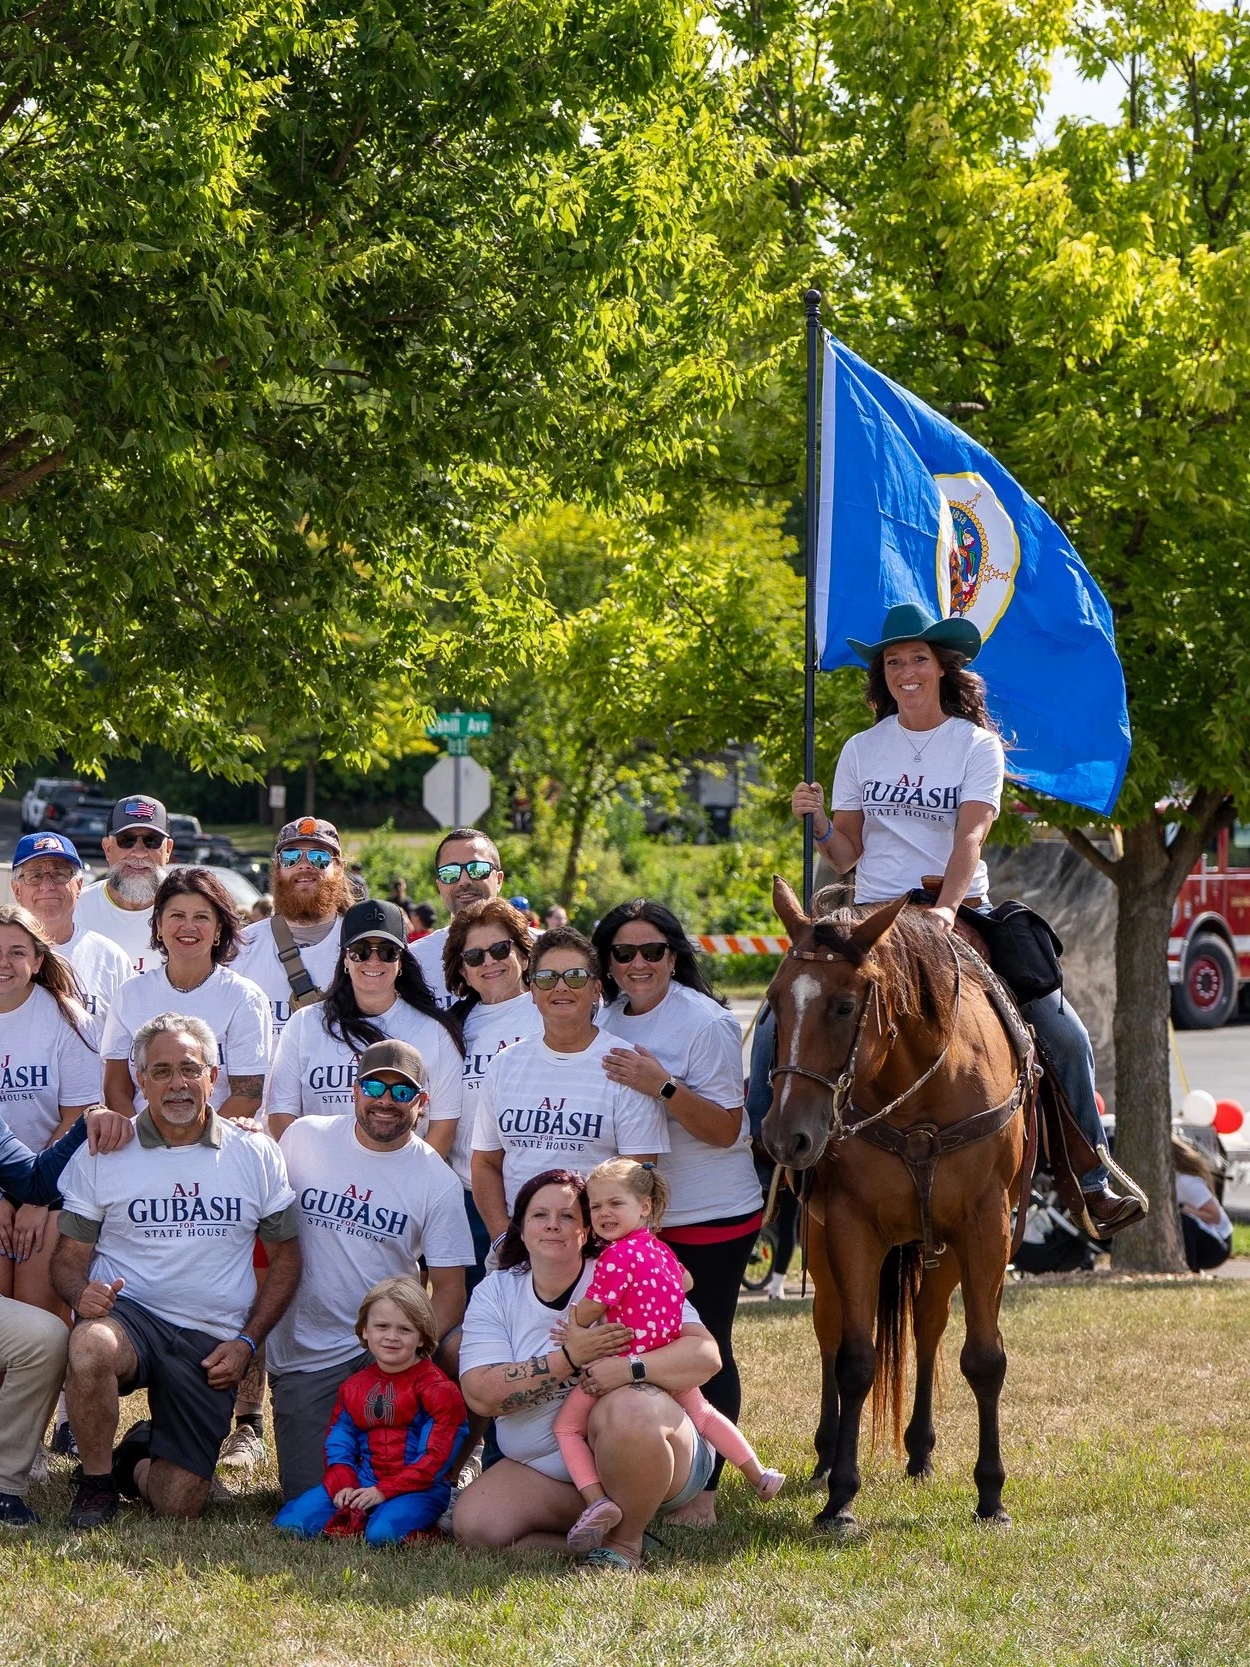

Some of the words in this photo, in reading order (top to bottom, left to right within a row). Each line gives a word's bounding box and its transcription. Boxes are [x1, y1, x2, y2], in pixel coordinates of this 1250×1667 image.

[951, 509, 967, 525] 1858
[467, 716, 489, 734] Ave
[896, 773, 925, 788] AJ
[862, 780, 959, 810] GUBASH
[867, 808, 900, 817] STATE
[905, 809, 945, 823] HOUSE
[0, 1092, 35, 1103] HOUSE
[538, 1097, 567, 1112] AJ
[498, 1108, 605, 1139] GUBASH
[510, 1139, 542, 1149] STATE
[545, 1141, 585, 1152] HOUSE
[172, 1182, 200, 1198] AJ
[343, 1183, 374, 1202] AJ
[127, 1196, 242, 1223] GUBASH
[300, 1187, 409, 1236] GUBASH
[307, 1217, 342, 1232] STATE
[346, 1227, 387, 1244] HOUSE
[340, 1219, 357, 1228] FOR
[144, 1229, 183, 1238] STATE
[187, 1228, 228, 1237] HOUSE
